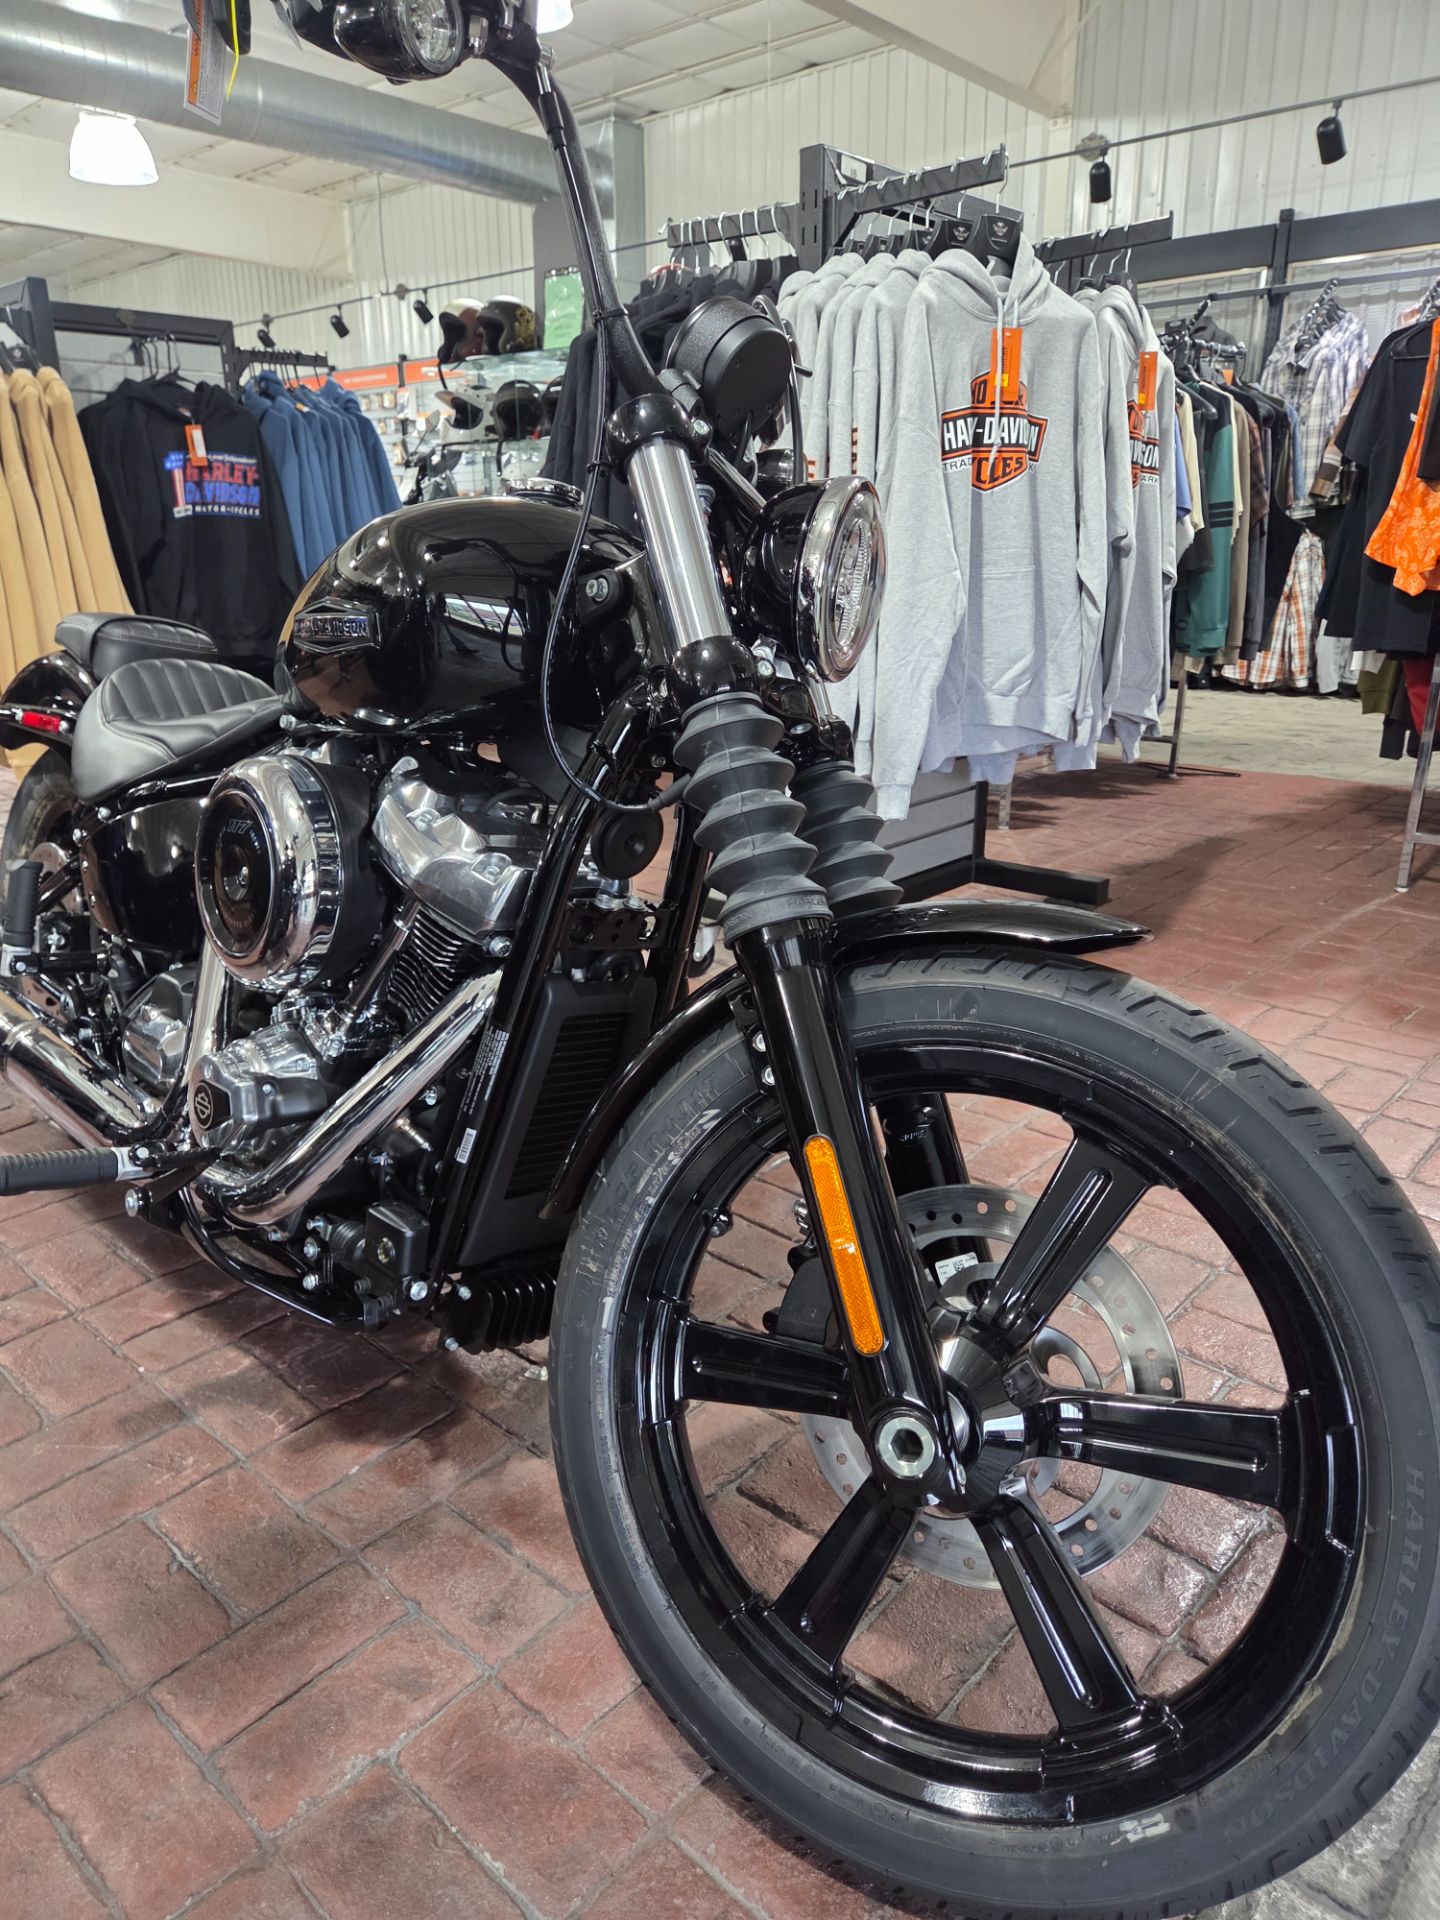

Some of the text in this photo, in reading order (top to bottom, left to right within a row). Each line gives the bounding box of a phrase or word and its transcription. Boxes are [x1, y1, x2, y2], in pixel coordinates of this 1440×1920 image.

[974, 457, 1024, 485] CLES
[185, 481, 260, 506] DAVIDSON
[226, 819, 252, 834] 117
[1223, 1462, 1426, 1845] HARLEY-DAVIDSON
